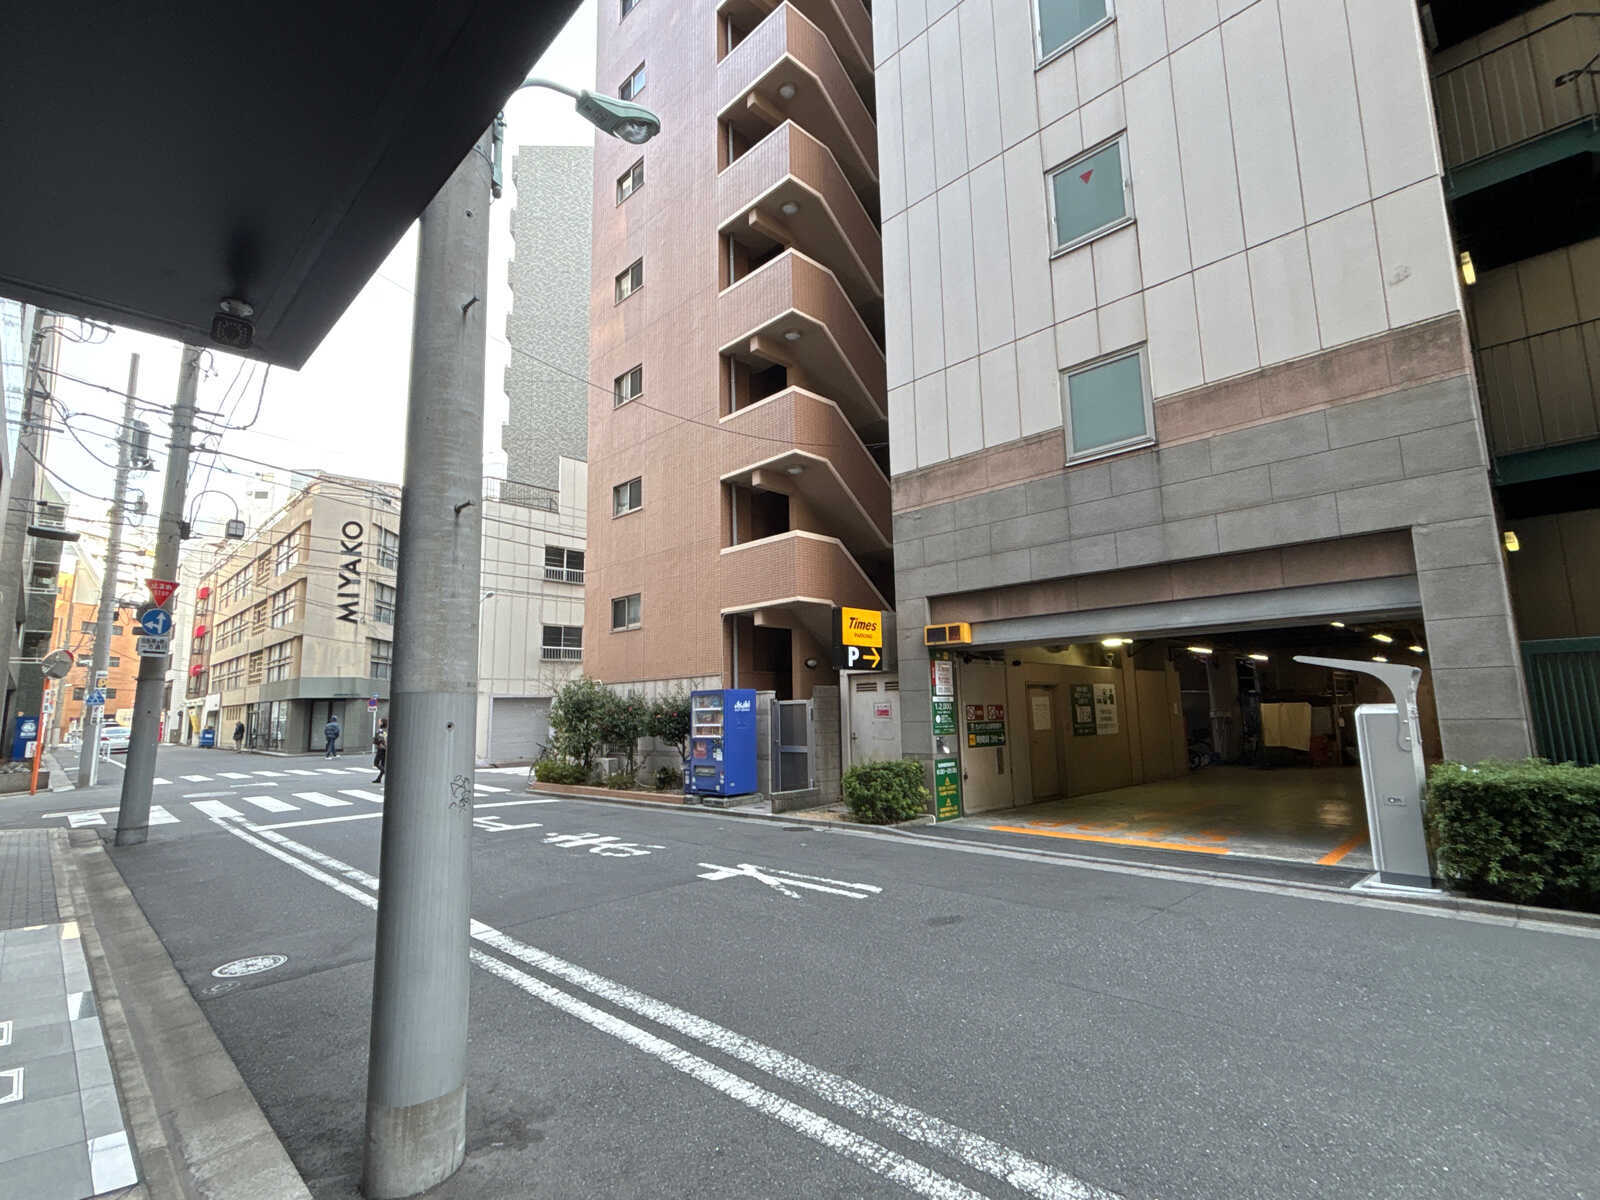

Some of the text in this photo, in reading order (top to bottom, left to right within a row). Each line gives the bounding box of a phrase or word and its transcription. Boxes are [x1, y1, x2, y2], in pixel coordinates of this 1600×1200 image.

[337, 521, 363, 624] MIYAKO
[848, 616, 878, 632] Times
[847, 645, 860, 667] P
